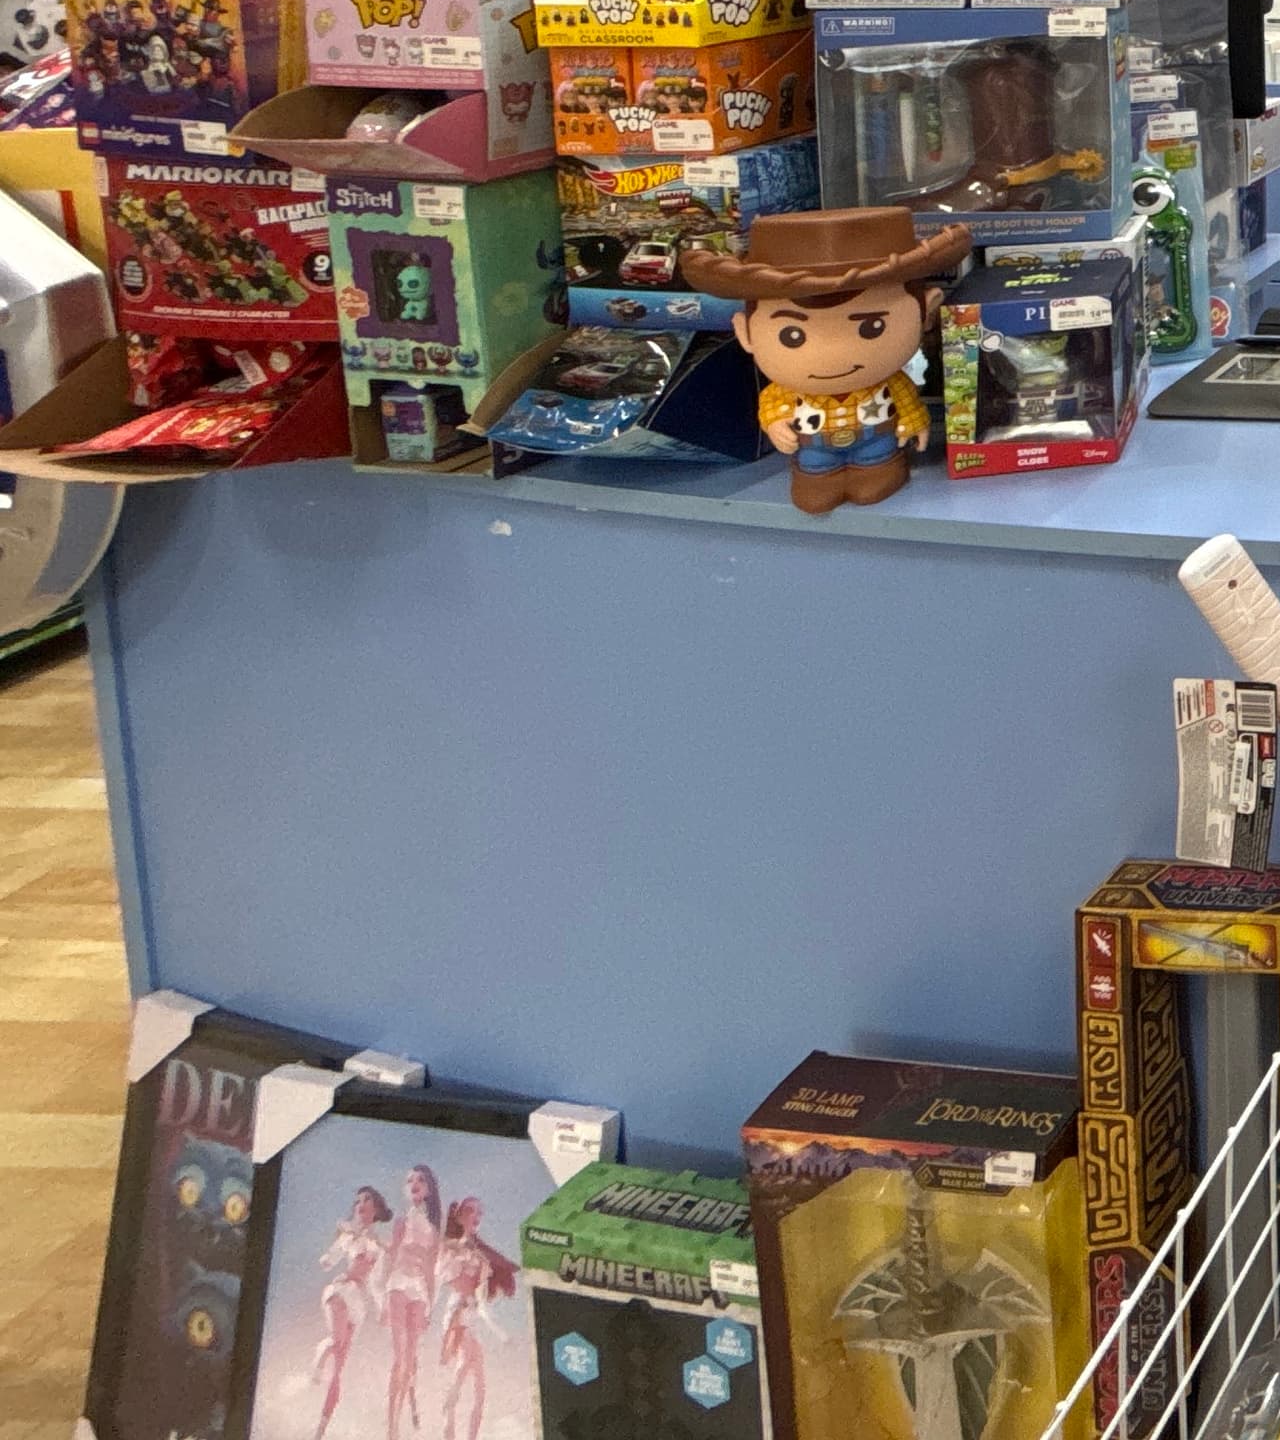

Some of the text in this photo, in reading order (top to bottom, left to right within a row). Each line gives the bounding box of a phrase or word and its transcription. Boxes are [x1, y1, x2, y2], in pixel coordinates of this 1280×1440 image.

[597, 11, 635, 23] POP
[713, 4, 750, 26] POP
[843, 18, 893, 27] WARNING!
[723, 91, 770, 112] PUCHI
[728, 110, 764, 129] POP
[617, 165, 683, 187] HOT WHEE
[337, 188, 393, 210] Stitch
[257, 201, 326, 225] BACKPAC
[1018, 448, 1048, 457] SNOW
[161, 1062, 253, 1135] DE
[916, 1098, 1062, 1135] LORD RINGS
[585, 1182, 750, 1234] MINECRAF
